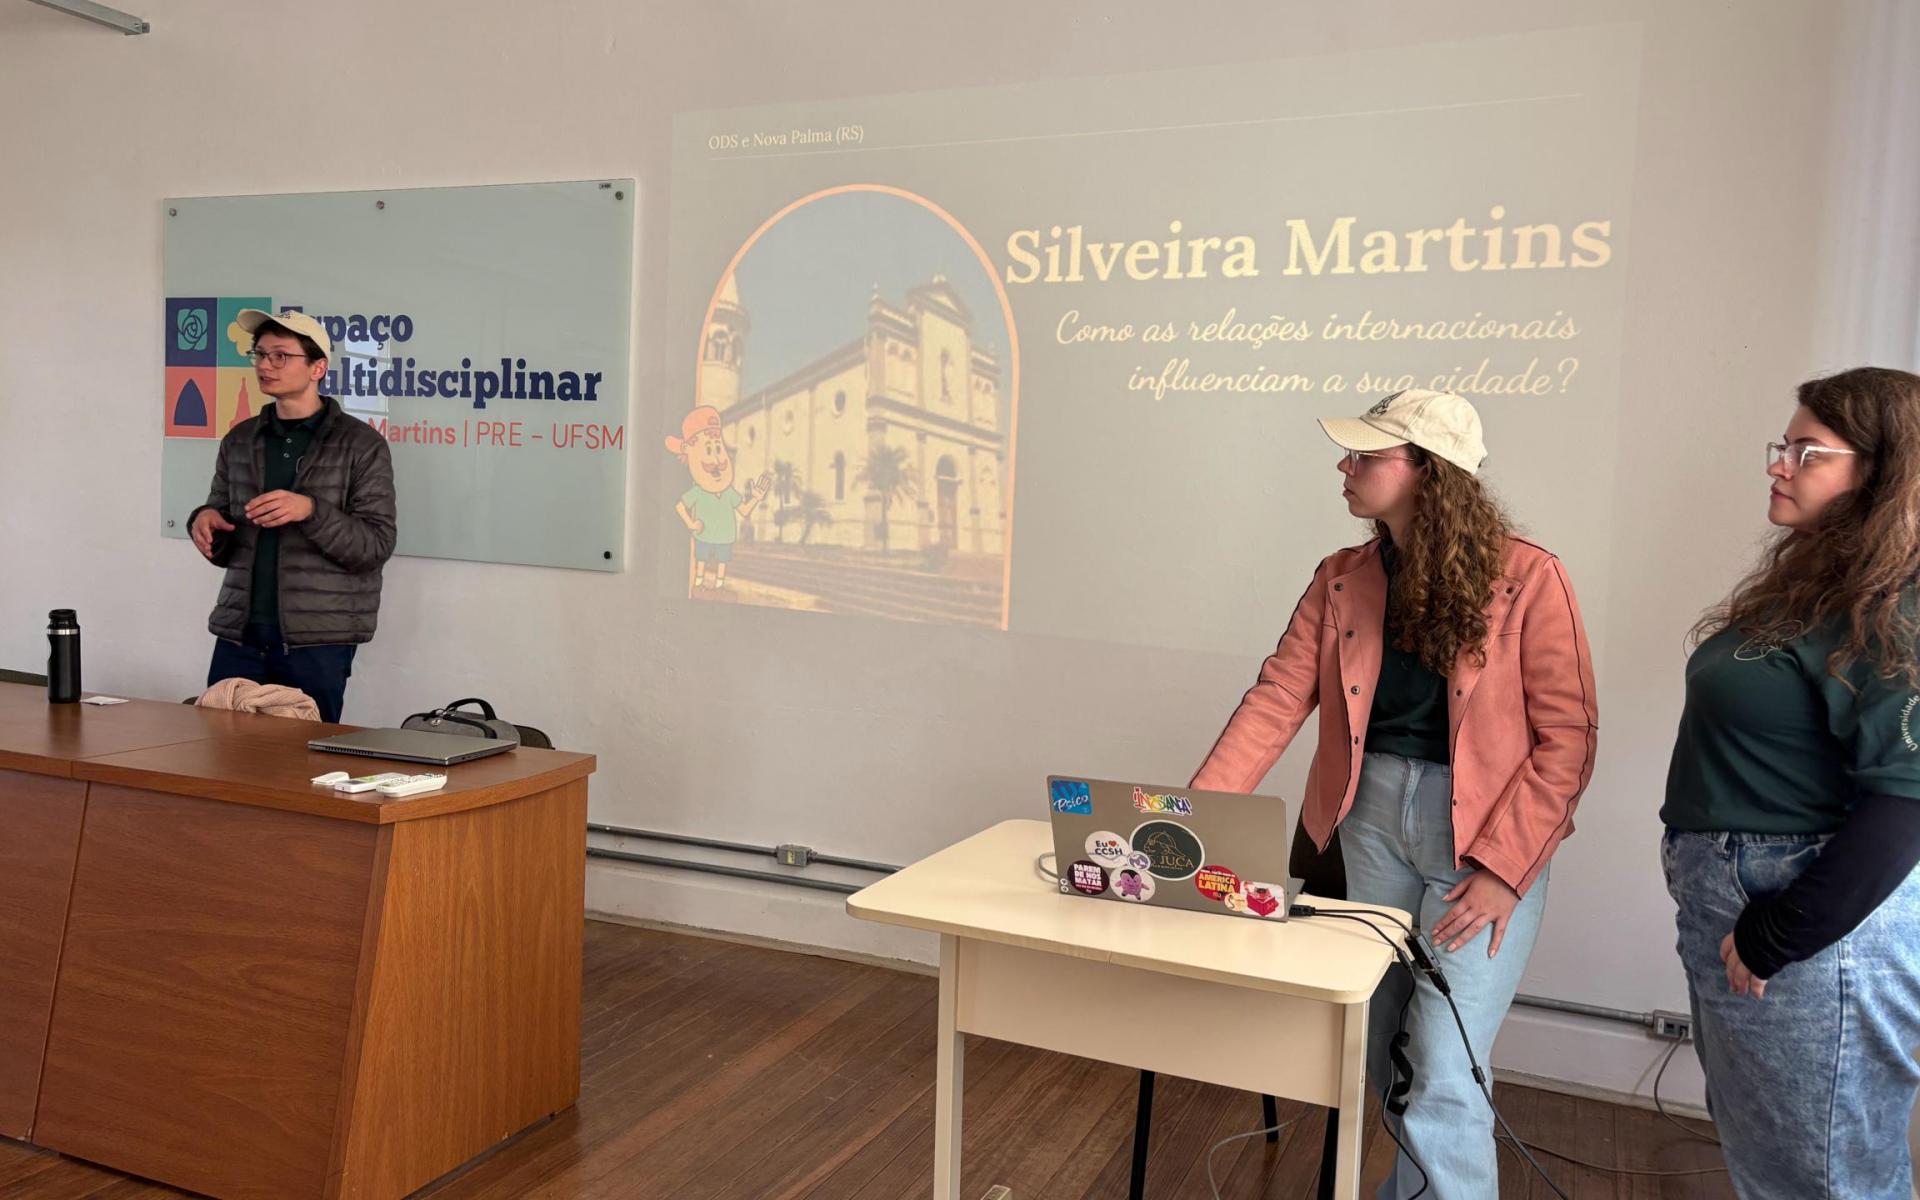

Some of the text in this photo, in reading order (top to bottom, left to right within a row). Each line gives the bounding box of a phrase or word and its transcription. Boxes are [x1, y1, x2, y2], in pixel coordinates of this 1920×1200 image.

[708, 124, 864, 150] ODS e Nova Palma (RS)
[1006, 205, 1612, 284] Silveira Martins
[280, 306, 413, 351] paço
[1055, 307, 1582, 350] Como as relações internacionais
[319, 357, 602, 409] ultidisciplinar
[1128, 357, 1580, 401] influenciam a sua cidade?
[476, 421, 523, 446] PRE
[552, 423, 624, 450] UFSM
[1095, 840, 1108, 848] Eu
[1199, 880, 1235, 893] LATINA
